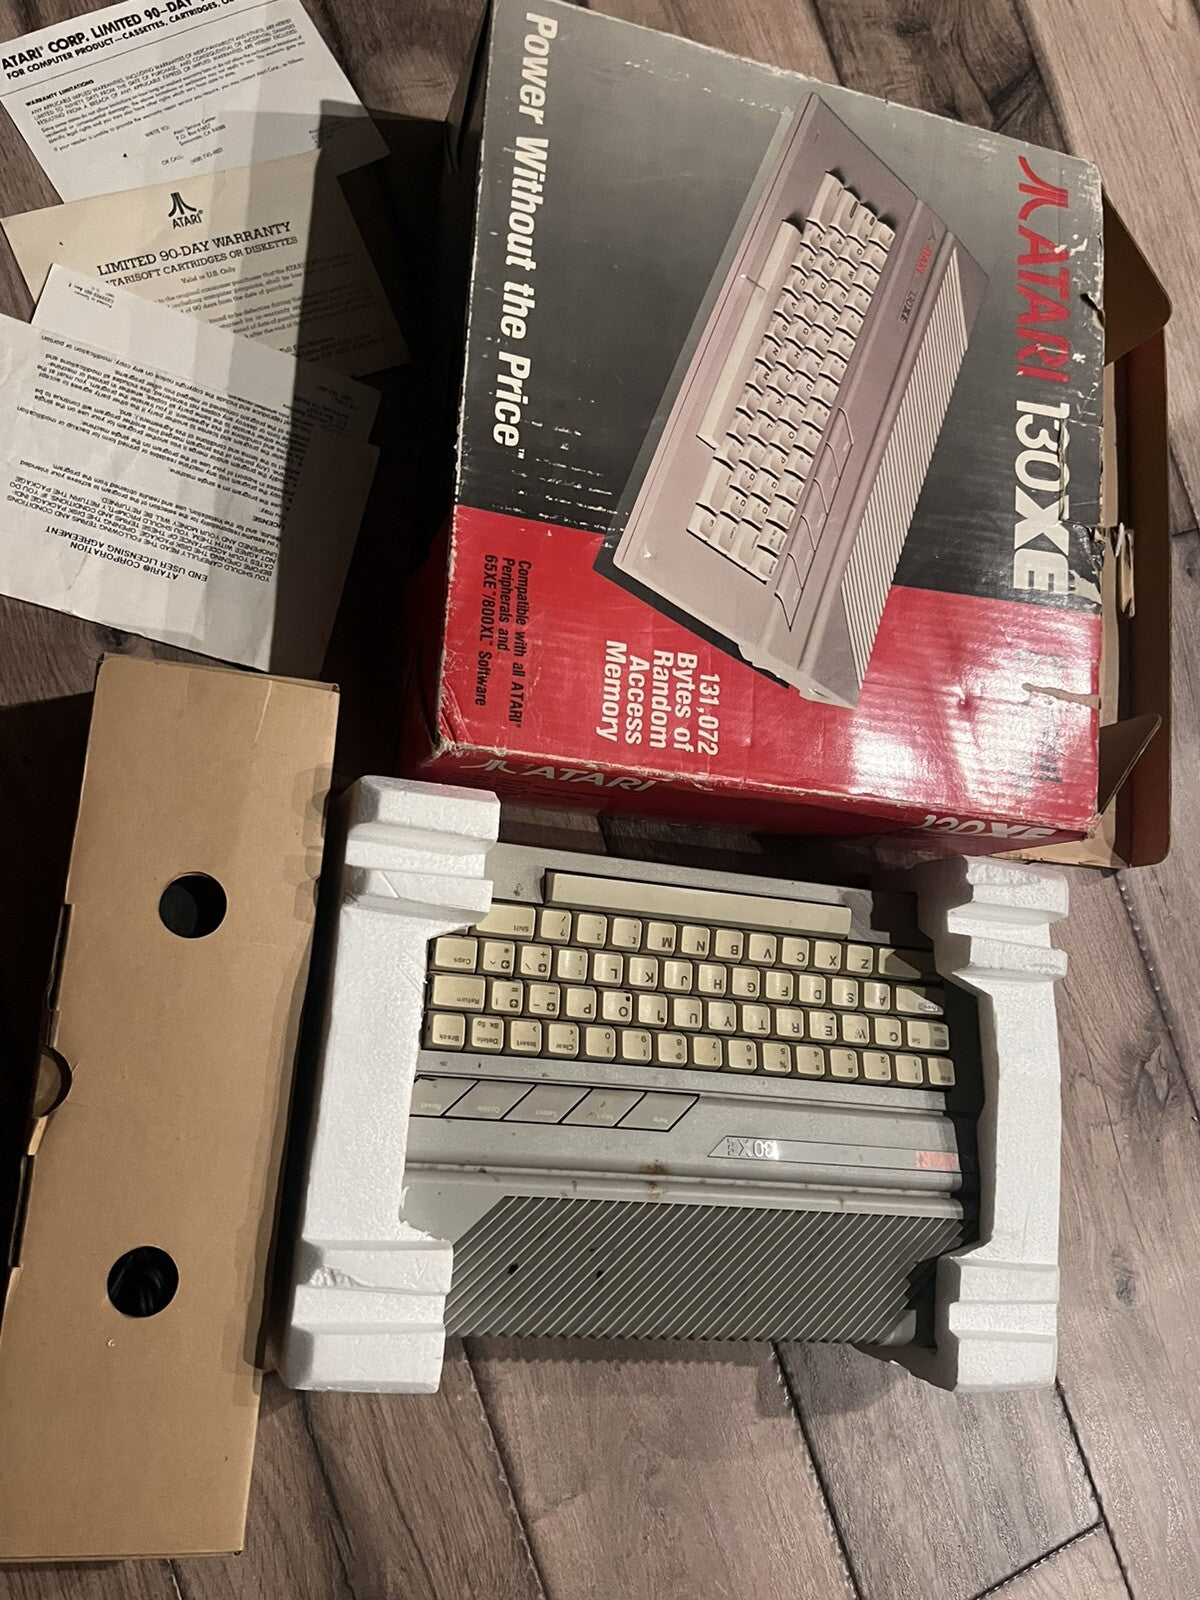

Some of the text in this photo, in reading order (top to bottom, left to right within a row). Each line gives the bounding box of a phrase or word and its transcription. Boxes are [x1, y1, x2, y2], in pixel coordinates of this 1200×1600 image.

[48, 32, 89, 52] CORP.
[92, 14, 141, 38] LIMITED
[6, 68, 25, 79] FOR
[27, 52, 73, 72] COMPUTER
[519, 12, 558, 125] Power
[506, 137, 549, 270] Without
[98, 221, 290, 275] LIMITED 90-DAY WARRANTY
[163, 252, 227, 274] CARTRIDGES
[229, 249, 243, 258] OR
[245, 236, 297, 254] DISKETTES
[500, 281, 535, 340] the
[1014, 224, 1070, 595] ATARI 130XE
[9, 481, 21, 489] DO
[15, 476, 51, 492] PACKAGE
[22, 486, 38, 495] YOU
[52, 488, 67, 498] THE
[30, 495, 67, 511] PACKAGE
[69, 494, 100, 508] RETURN
[54, 510, 70, 519] AND
[68, 508, 85, 517] DISK
[86, 513, 101, 522] THE
[97, 510, 113, 518] AND
[102, 505, 141, 521] PROMPTLY
[143, 510, 153, 518] BE
[72, 516, 96, 528] TERMS
[114, 515, 139, 527] TERMS
[142, 518, 172, 531] SHOULD
[155, 514, 170, 524] WILL
[103, 518, 136, 533] OPENING
[141, 524, 165, 536] THESE
[172, 521, 198, 533] MONEY
[99, 524, 142, 542] FOLLOWING
[173, 527, 188, 536] YOU
[199, 529, 219, 540] YOUR
[143, 538, 157, 547] THE
[179, 536, 227, 555] ACCEPTANCE
[214, 541, 232, 550] WITH
[221, 536, 236, 544] AND
[159, 544, 180, 554] READ
[175, 542, 192, 551] DISK
[193, 547, 207, 556] THE
[237, 541, 277, 558] UNOPENED
[45, 526, 207, 581] END USER LICENSING AGREEMENT
[70, 541, 140, 568] CORPORATION
[228, 552, 247, 562] YOUR
[234, 547, 259, 558] AGREE
[181, 551, 222, 567] CAREFULLY
[209, 553, 242, 567] OPENING
[250, 558, 273, 570] CATES
[260, 555, 276, 564] NOT
[223, 564, 253, 577] SHOULD
[243, 563, 272, 576] BEFORE
[254, 573, 269, 582] YOU
[516, 561, 531, 625] Compatible
[497, 557, 514, 651] Peripherals and
[513, 631, 527, 656] with
[512, 662, 525, 676] all
[475, 651, 491, 705] Software
[596, 641, 626, 740] Memory
[625, 655, 649, 743] Access
[650, 650, 673, 747] Random
[673, 652, 697, 752] Bytes of
[698, 674, 719, 754] 131,072
[520, 766, 657, 791] ATARI
[513, 924, 529, 932] Shift
[661, 936, 672, 947] M
[696, 940, 705, 951] N
[729, 944, 739, 955] B
[763, 948, 772, 959] V
[453, 956, 471, 964] Caps
[796, 952, 805, 962] C
[828, 955, 837, 966] X
[860, 958, 869, 969] Z
[609, 967, 617, 978] L
[643, 971, 654, 983] K
[680, 975, 687, 986] J
[713, 978, 722, 989] H
[746, 982, 756, 993] G
[781, 986, 789, 996] F
[456, 995, 479, 1004] Return
[812, 989, 822, 999] D
[845, 992, 854, 1003] S
[878, 995, 886, 1005] A
[583, 1002, 592, 1014] P
[617, 1006, 628, 1017] O
[688, 1012, 698, 1023] U
[723, 1016, 732, 1027] Y
[758, 1019, 766, 1030] T
[790, 1022, 800, 1033] R
[824, 1025, 833, 1036] E
[438, 1033, 459, 1041] Break
[476, 1035, 498, 1044] Delete
[675, 1038, 682, 1046] 8
[888, 1031, 898, 1042] Q
[516, 1038, 536, 1047] Insert
[555, 1042, 573, 1050] Clear
[745, 1044, 751, 1052] 6
[779, 1047, 785, 1055] 5
